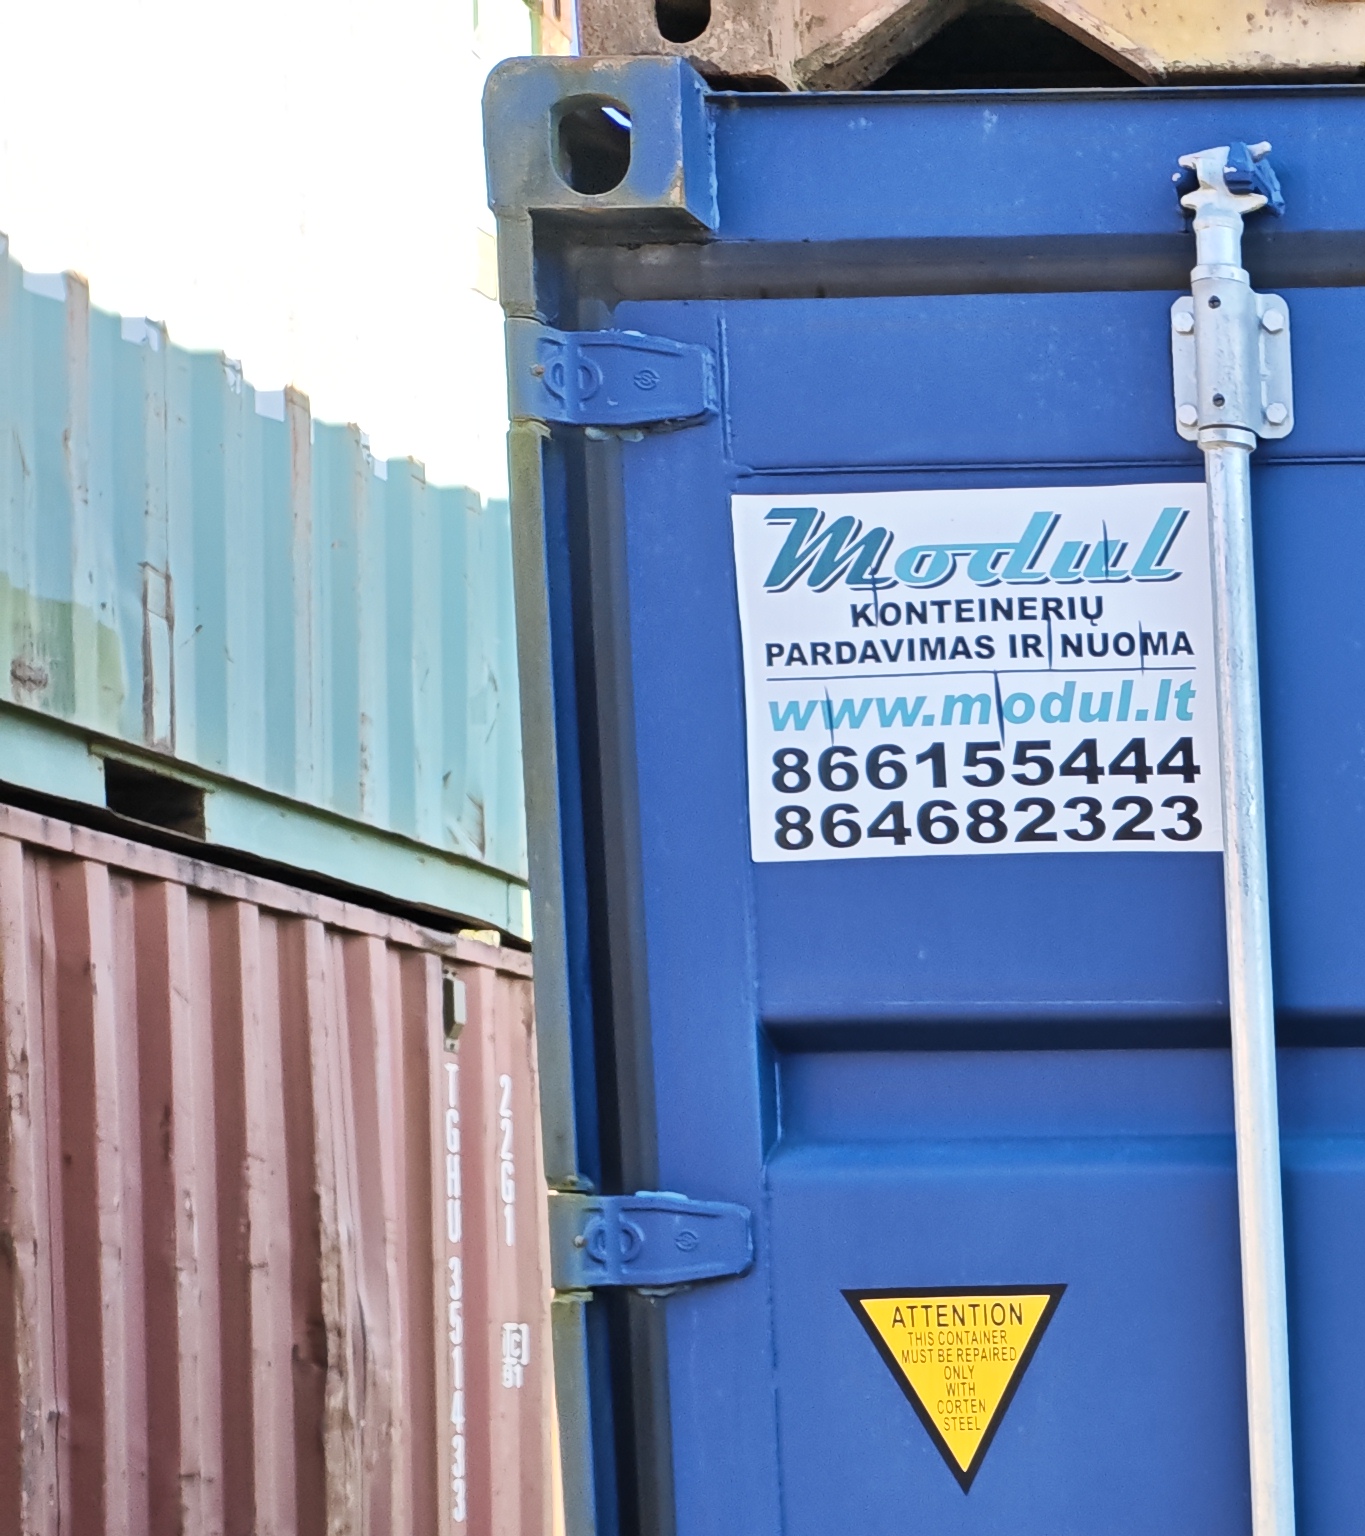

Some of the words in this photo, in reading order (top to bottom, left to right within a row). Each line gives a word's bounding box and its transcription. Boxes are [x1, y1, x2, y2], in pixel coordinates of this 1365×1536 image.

[763, 507, 1189, 592] Modul
[850, 596, 1103, 627] KONTEINERIŲ
[765, 634, 995, 666] PARDAVIMAS
[1009, 633, 1043, 659] IR
[1060, 631, 1194, 657] NUOMA
[769, 679, 1197, 731] www.modul.lt
[771, 736, 1201, 793] 866155444
[773, 795, 1203, 850] 864682323
[444, 1062, 462, 1244] TGHU
[499, 1074, 516, 1246] 22G1
[892, 1303, 1023, 1328] ATTENTION
[907, 1331, 934, 1346] THIS
[938, 1330, 1007, 1346] CONTAINER
[901, 1349, 933, 1364] MUST
[938, 1348, 953, 1363] BE
[956, 1347, 1017, 1362] REPAIRED
[944, 1365, 974, 1380] ONLY
[946, 1382, 976, 1396] WITH
[937, 1399, 986, 1414] CORTEN
[943, 1416, 981, 1431] STEEL
